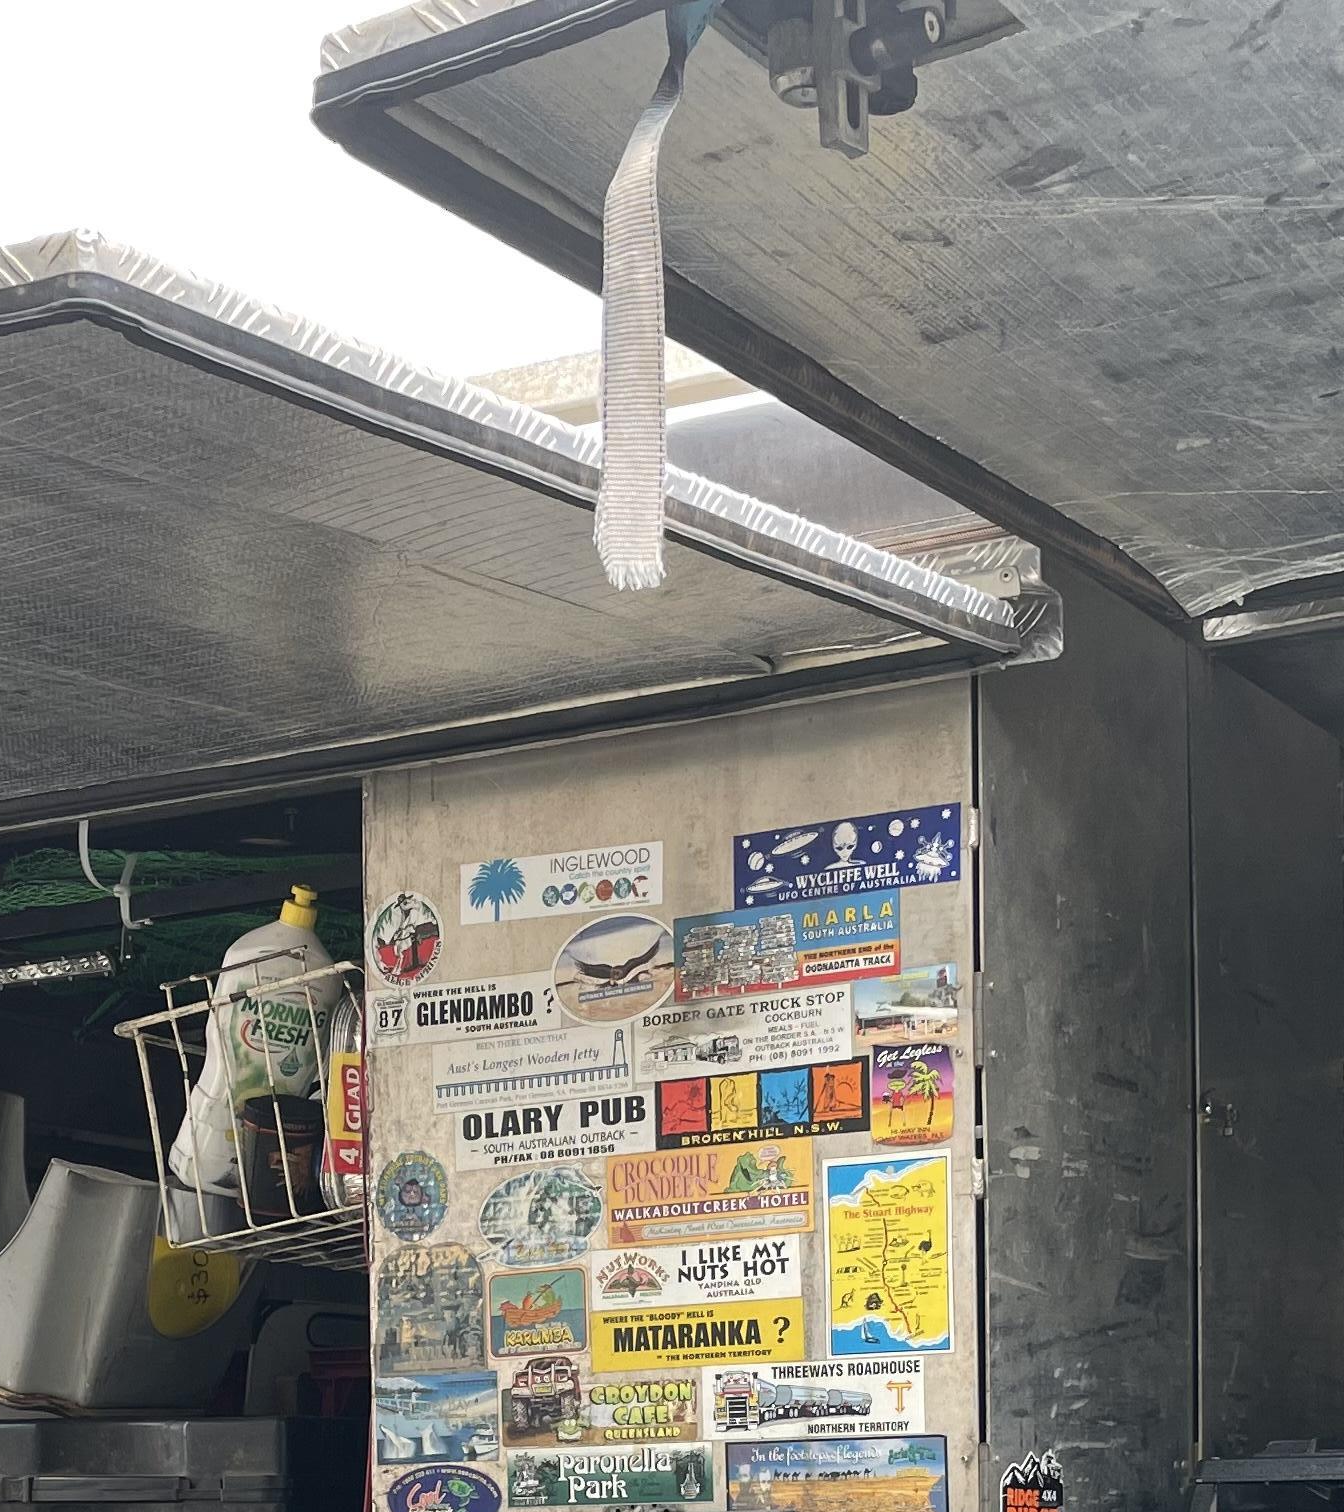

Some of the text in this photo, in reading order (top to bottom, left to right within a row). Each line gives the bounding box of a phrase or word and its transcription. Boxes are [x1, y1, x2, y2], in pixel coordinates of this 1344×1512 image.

[551, 848, 650, 873] INGLEWOOD
[796, 862, 900, 888] WYCLIFFE WELL
[779, 875, 916, 900] UFO CENTRE OF AUSTRALIA
[803, 902, 893, 927] MARLA
[803, 920, 893, 940] SOUTH AUSTRALIA
[806, 956, 891, 972] OODNADATTA TRACK
[413, 989, 443, 999] WHERE
[446, 988, 462, 996] THE
[465, 986, 485, 994] HELL
[241, 997, 326, 1028] MORNING
[379, 1009, 402, 1028] 87
[417, 991, 533, 1026] GLENDAMBO
[643, 992, 844, 1026] BORDER GATE TRUCK STOP
[765, 1009, 822, 1023] COCKBURN
[251, 1020, 310, 1046] FRESH
[494, 1019, 537, 1030] AUSTRALIA
[447, 1048, 599, 1074] Aust's Longest Wooden Jetty
[877, 1044, 943, 1068] Get Legless
[346, 1068, 360, 1130] GLAD
[462, 1104, 563, 1140] OLARY
[580, 1096, 646, 1128] PUB
[484, 1130, 625, 1154] SOUTH AUSTRALIAN OUTBACK
[681, 1123, 843, 1146] BROKEN HILL N.S.W.
[340, 1148, 359, 1164] 4
[494, 1154, 532, 1164] PH/FAX
[612, 1154, 720, 1193] CROCODILE
[614, 1193, 807, 1221] WALKABOUT CREEK HOTEL
[844, 1206, 933, 1219] The Stuart Highway
[681, 1241, 786, 1265] I LIKE MY
[678, 1258, 789, 1283] NUTS HOT
[698, 1278, 761, 1290] YANDINA QLD
[706, 1289, 755, 1298] AUSTRALIA
[603, 1316, 628, 1324] WHERE
[506, 1328, 571, 1346] KARUMBA
[614, 1319, 761, 1352] MATARANKA
[683, 1352, 726, 1360] NORTHERN
[728, 1349, 771, 1357] TERRITORY
[772, 1360, 920, 1380] THREEWAYS ROADHOUSE
[590, 1383, 692, 1405] CROYDON
[613, 1406, 668, 1425] CAFE
[605, 1428, 680, 1440] QUEENSLAND
[808, 1421, 909, 1434] NORTHERN TERRITORY
[557, 1448, 672, 1481] Paronella
[567, 1473, 628, 1503] Park
[1007, 1488, 1040, 1506] RIDGE
